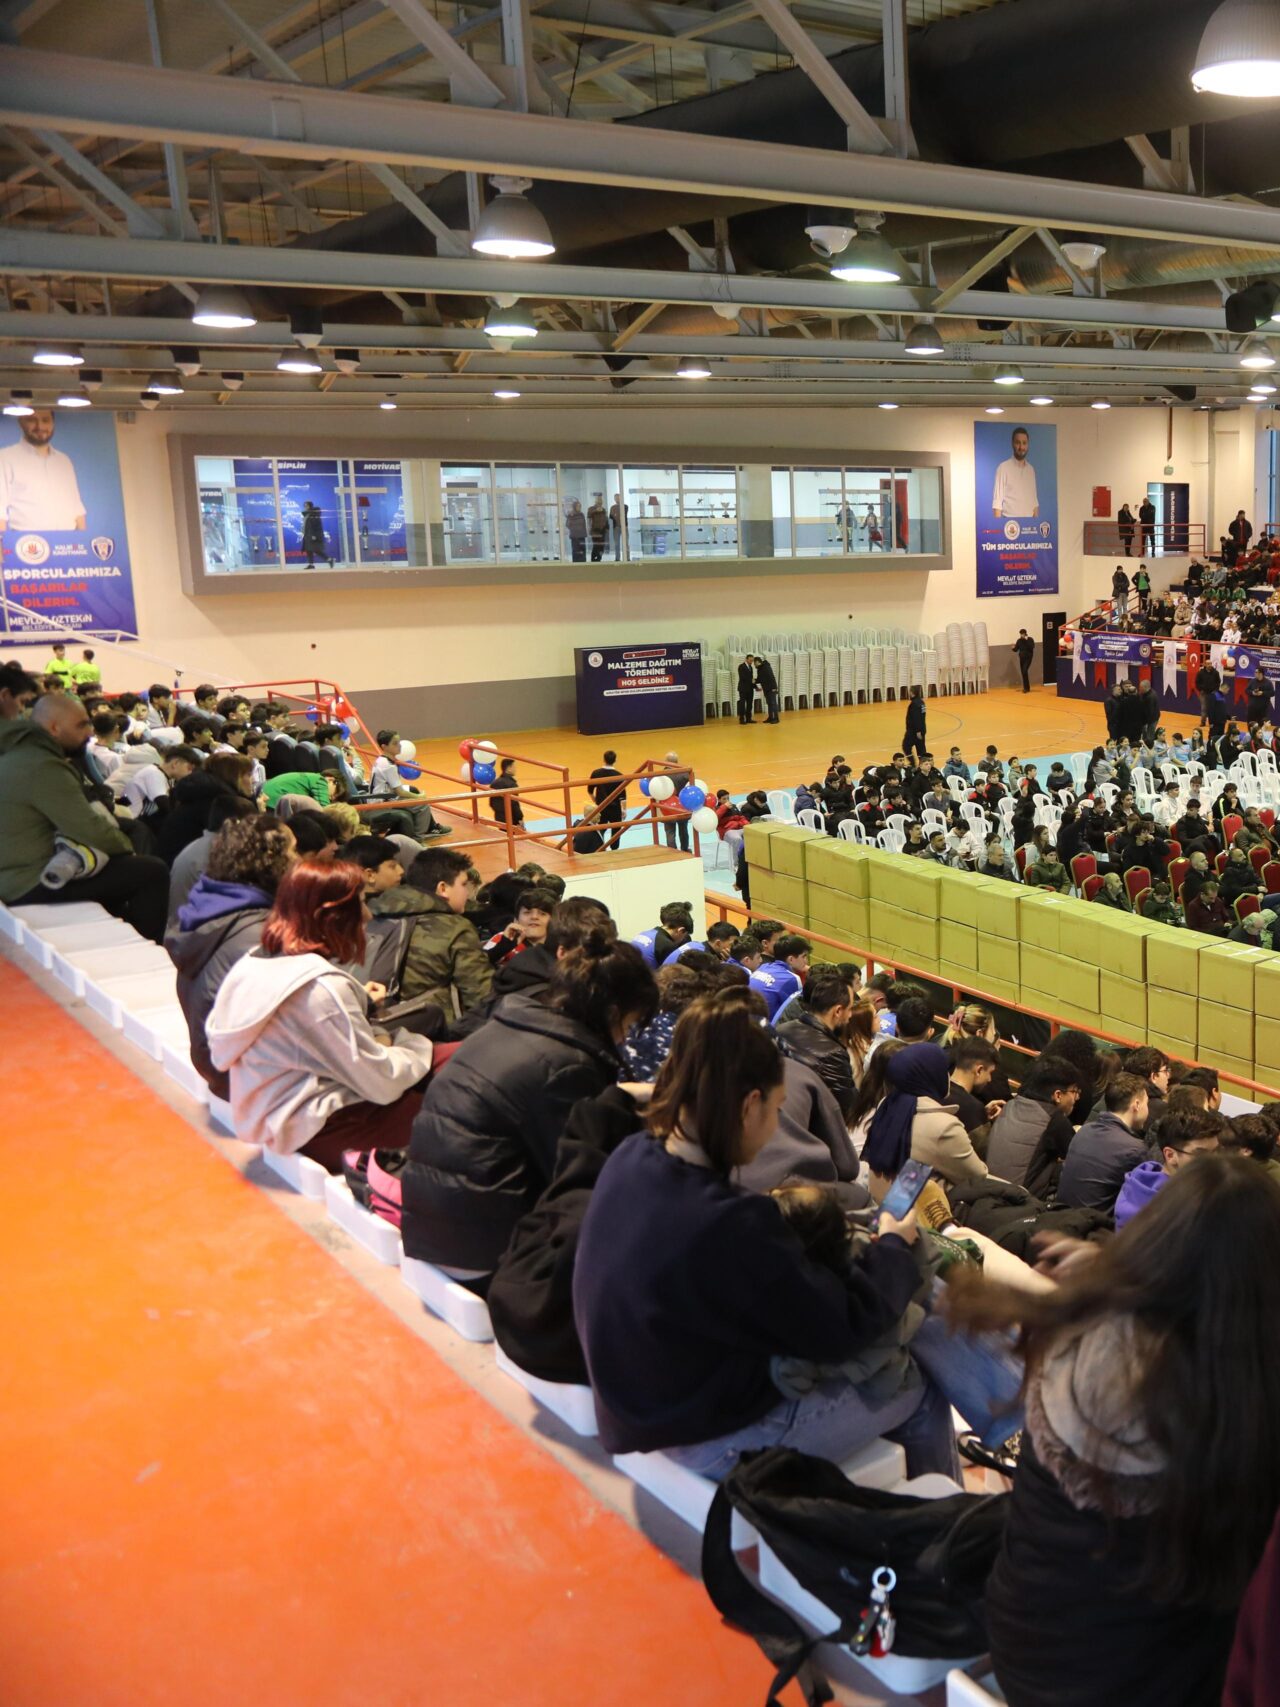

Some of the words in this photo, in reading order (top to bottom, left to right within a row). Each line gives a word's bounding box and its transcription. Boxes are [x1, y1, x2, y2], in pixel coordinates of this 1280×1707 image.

[363, 462, 401, 470] MOTİVAS
[3, 567, 122, 580] SPORCULARIMIZA
[607, 660, 647, 670] MALZEME
[648, 658, 682, 667] DAĞITIM
[625, 667, 666, 677] TÖRENİNE
[621, 678, 637, 686] HOŞ
[638, 676, 670, 685] GELDİNİZ
